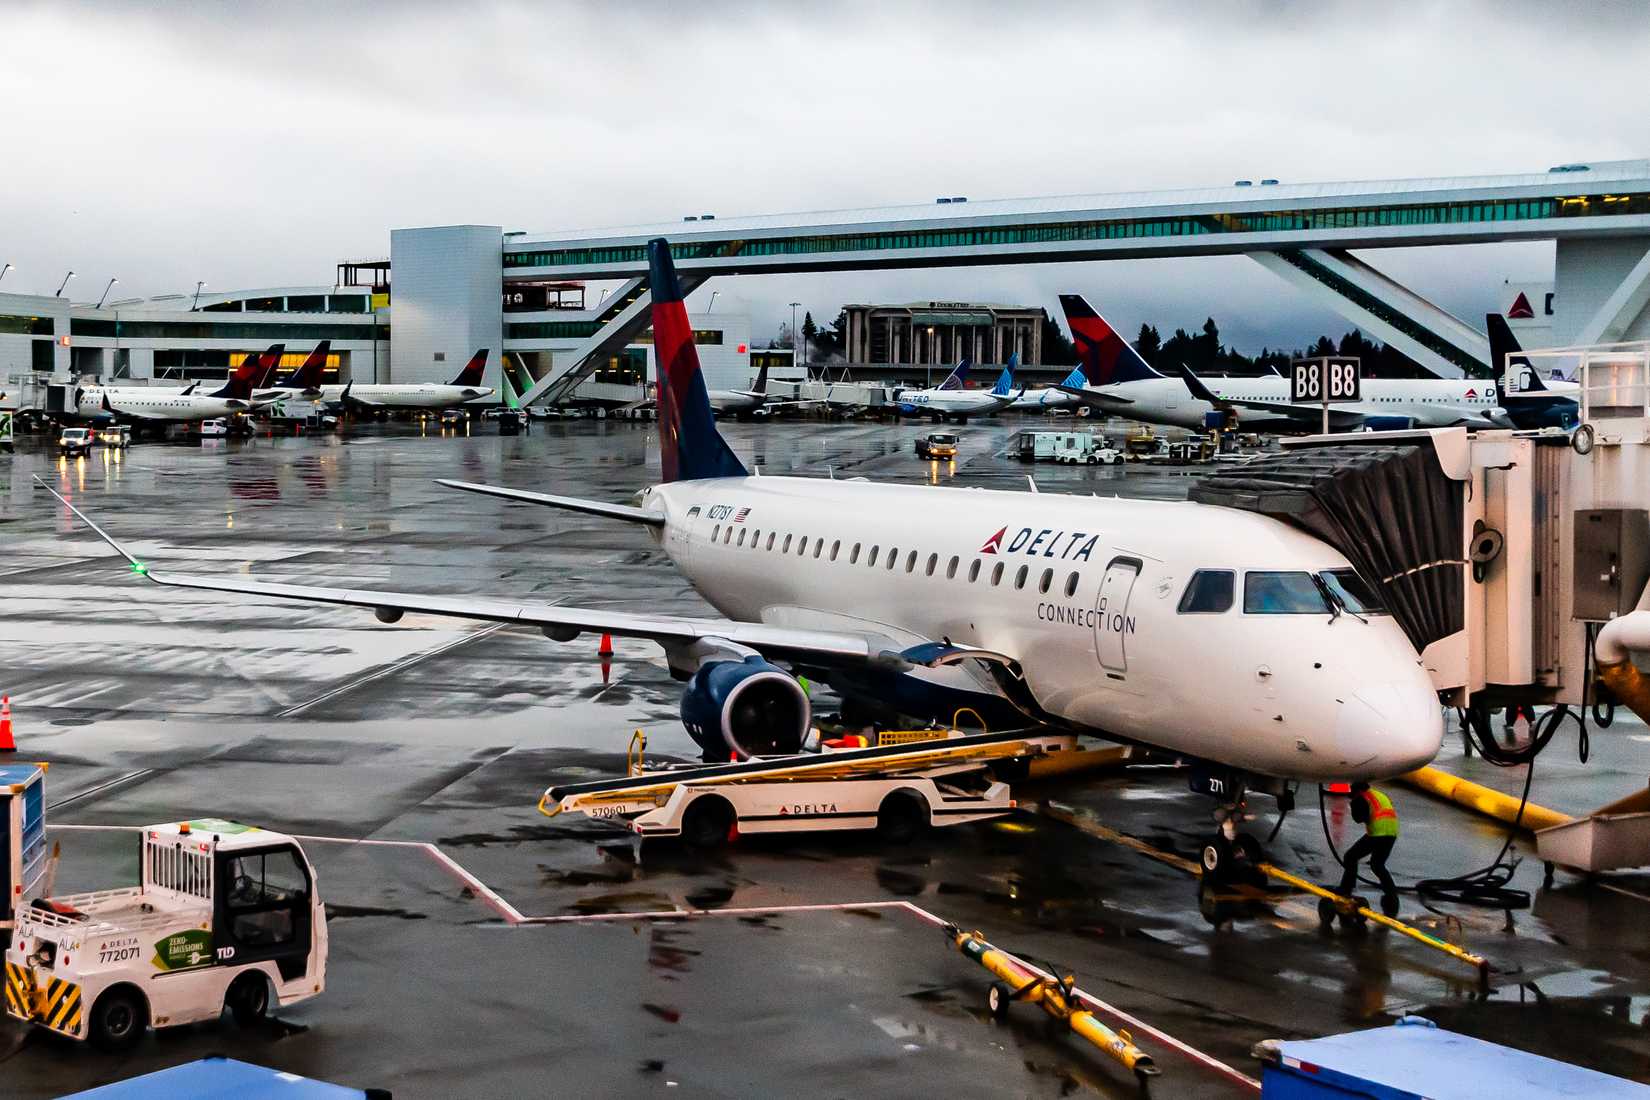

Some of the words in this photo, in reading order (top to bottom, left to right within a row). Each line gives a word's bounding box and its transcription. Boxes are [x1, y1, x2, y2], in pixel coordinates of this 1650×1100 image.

[1296, 365, 1320, 398] B8
[1331, 364, 1355, 397] B8
[1007, 527, 1100, 562] DELTA
[1037, 602, 1136, 634] CONNECTION
[1209, 778, 1224, 793] 271
[794, 803, 837, 814] DELTA
[110, 937, 138, 948] DELTA
[99, 946, 140, 963] 772071
[216, 946, 235, 959] TLD
